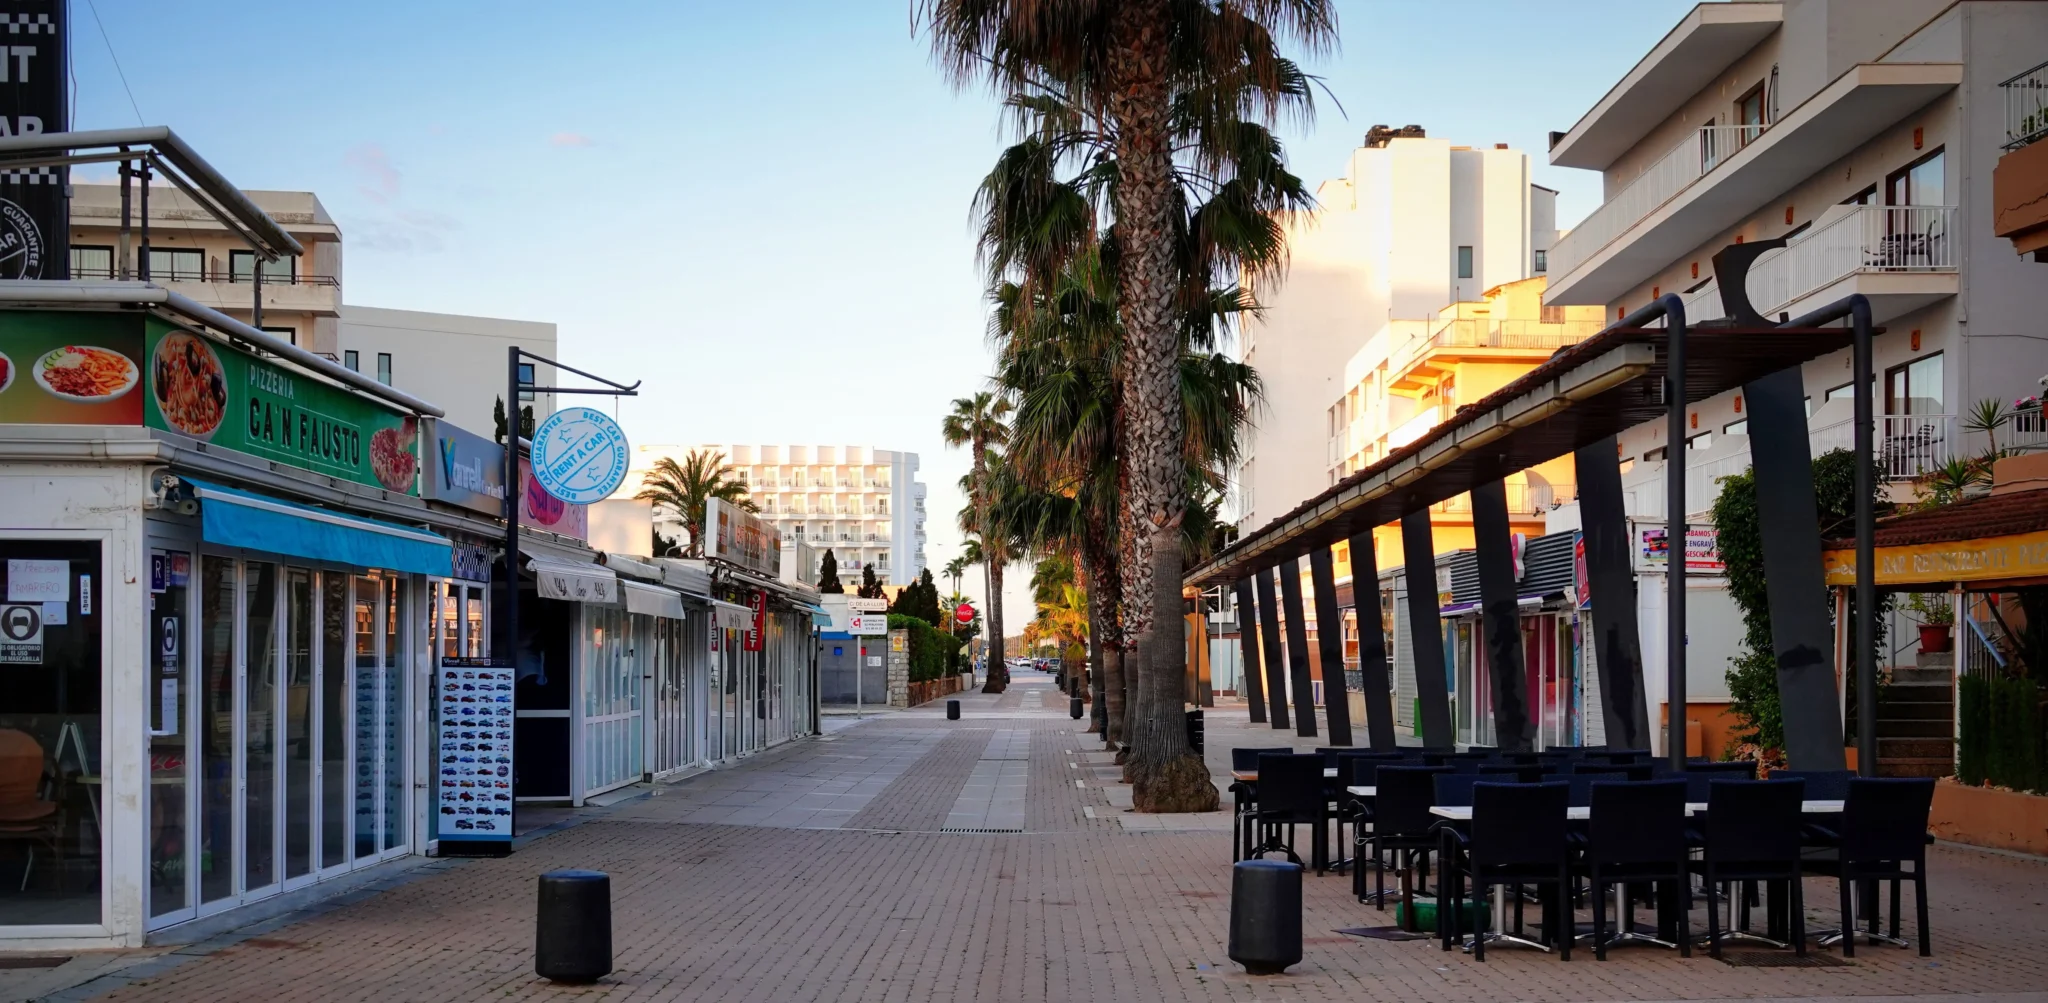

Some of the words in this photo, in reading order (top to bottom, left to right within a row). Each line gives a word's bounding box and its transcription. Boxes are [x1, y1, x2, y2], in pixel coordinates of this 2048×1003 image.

[3, 206, 39, 267] GUARANTEE
[250, 364, 294, 400] PIZZERIA
[583, 411, 606, 425] BEST
[606, 425, 621, 442] CAR
[299, 412, 360, 468] FAUSTO
[535, 416, 563, 465] GUARANTEE
[552, 454, 578, 479] RENT
[576, 448, 587, 459] A
[584, 432, 606, 452] CAR
[538, 469, 553, 485] CAR
[597, 446, 625, 495] GUARANTEE
[554, 486, 577, 500] BEST
[10, 581, 60, 594] CAMARERO
[155, 560, 161, 579] R
[749, 594, 761, 648] OUTLET
